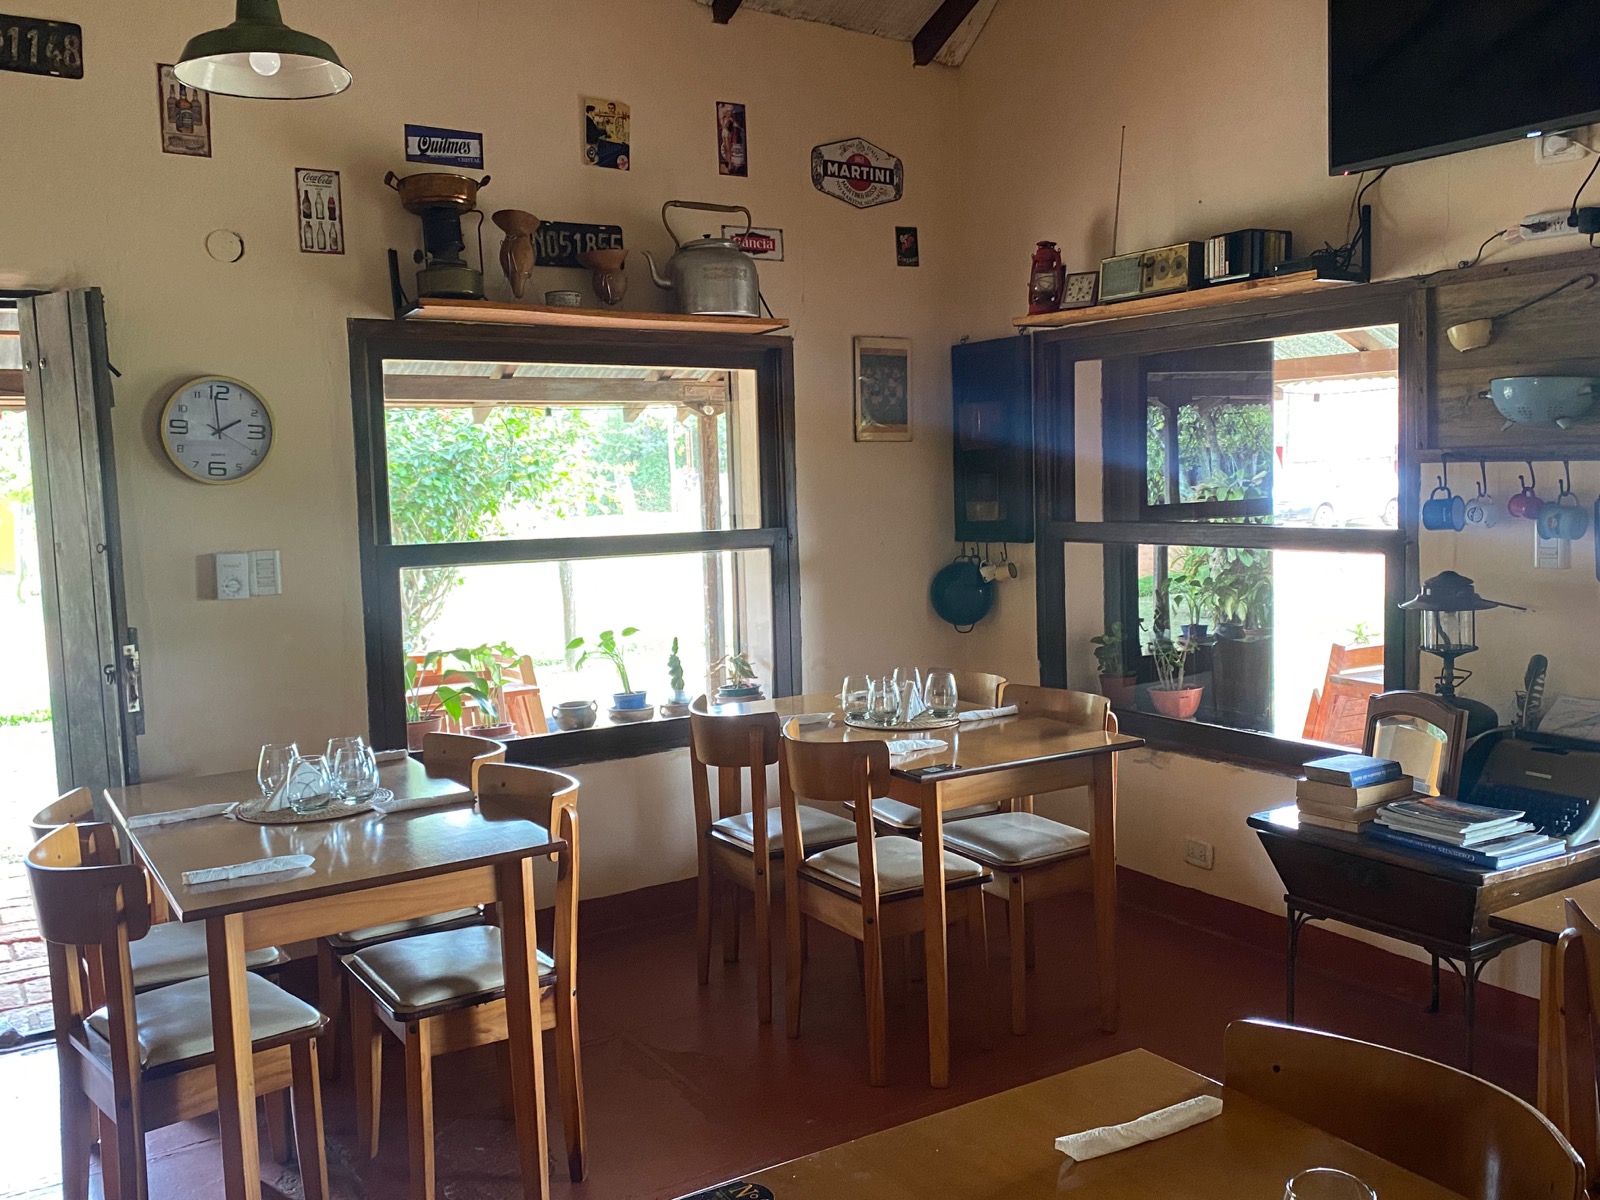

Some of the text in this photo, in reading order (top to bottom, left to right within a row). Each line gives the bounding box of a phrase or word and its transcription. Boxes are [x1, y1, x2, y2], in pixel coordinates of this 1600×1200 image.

[0, 27, 81, 67] 1148
[418, 137, 471, 156] Quilmes
[827, 162, 890, 183] MARTINI
[194, 391, 201, 399] 11
[208, 385, 230, 401] 12
[178, 404, 188, 413] 10
[251, 409, 259, 417] 2
[169, 419, 189, 435] 9
[247, 424, 266, 440] 3
[176, 444, 185, 453] 8
[208, 461, 227, 477] 6
[235, 463, 243, 471] 5
